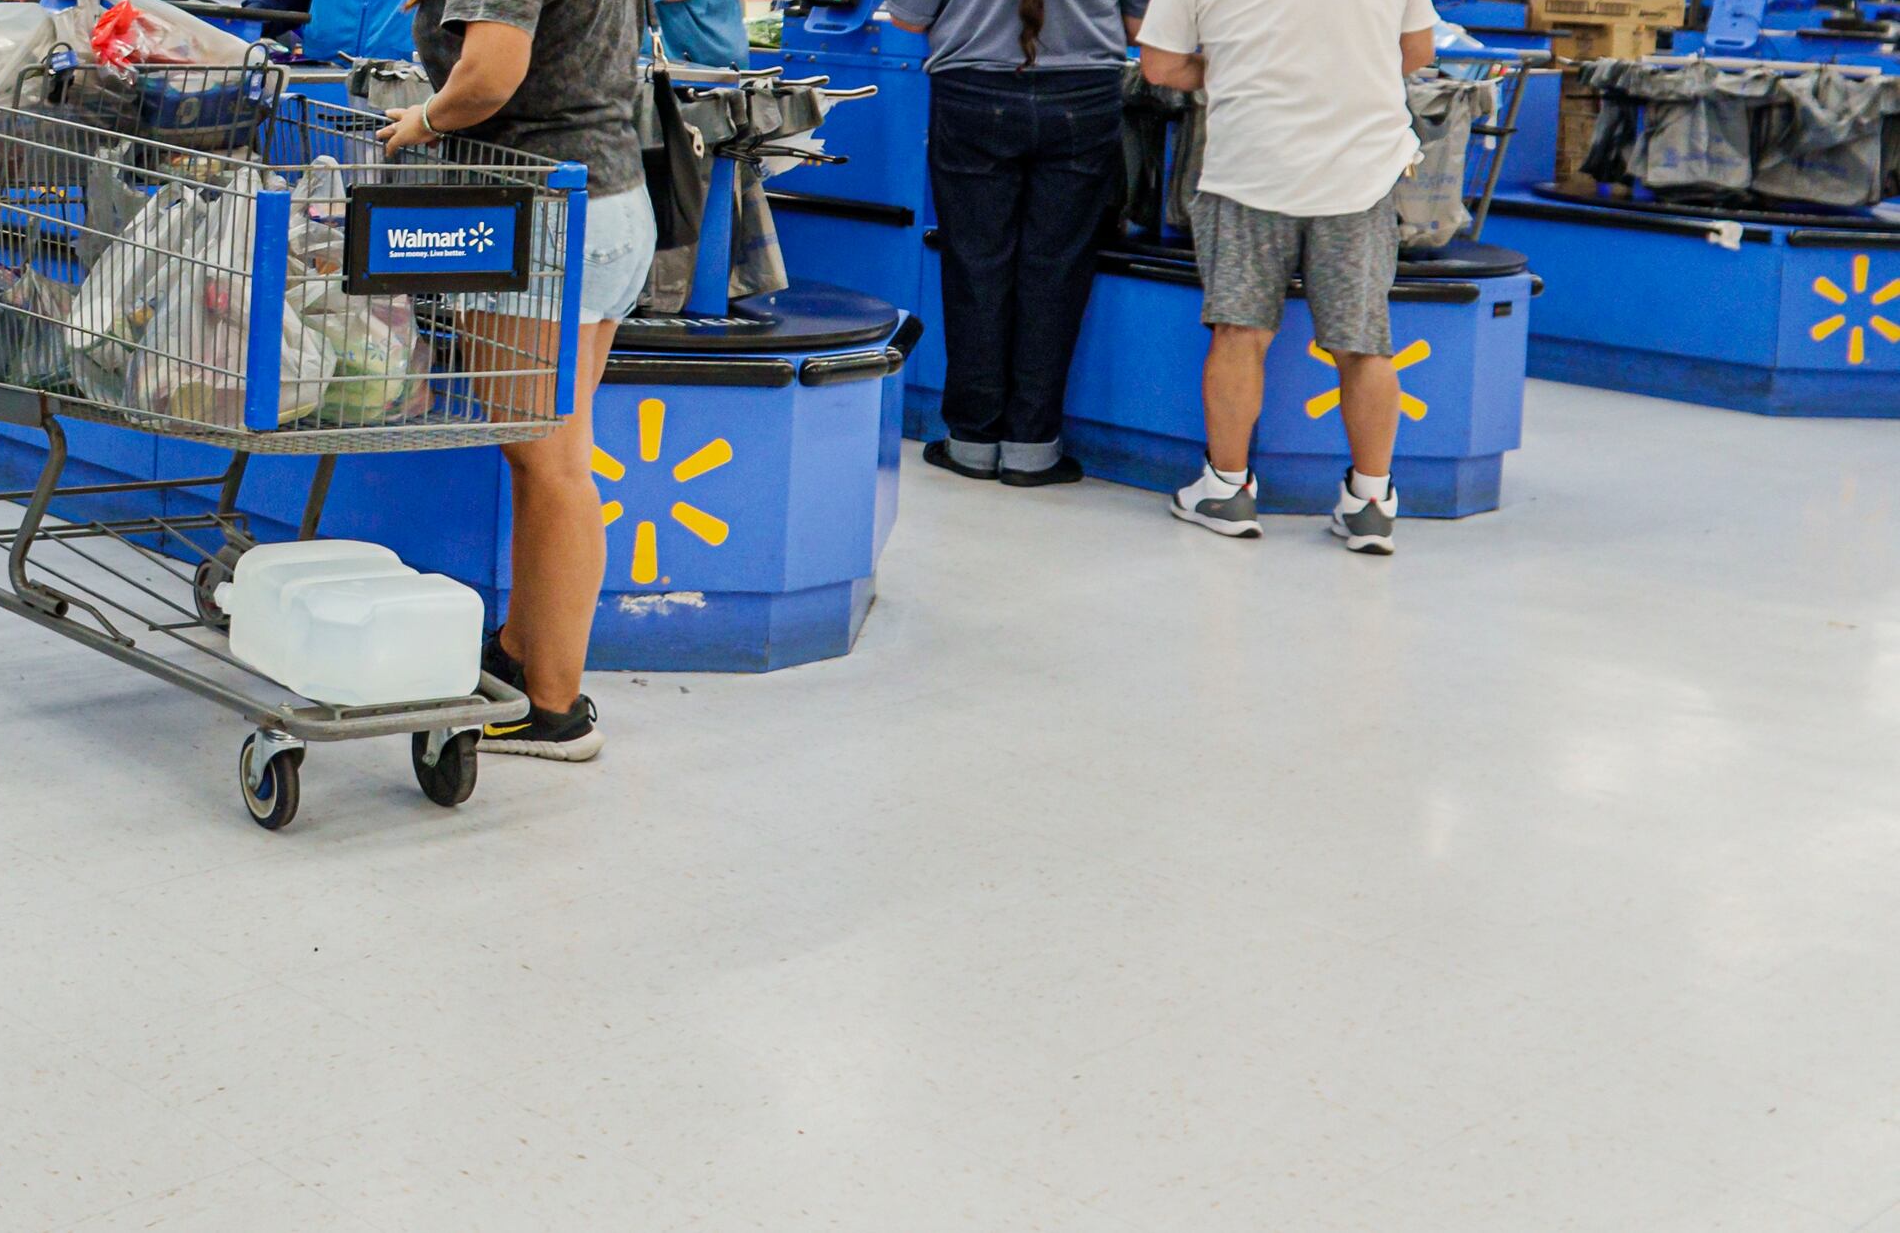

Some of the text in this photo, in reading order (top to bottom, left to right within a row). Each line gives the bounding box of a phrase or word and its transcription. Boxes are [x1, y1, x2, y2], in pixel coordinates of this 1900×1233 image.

[388, 227, 466, 248] Walmart
[389, 250, 405, 258] Save
[406, 251, 429, 259] money.
